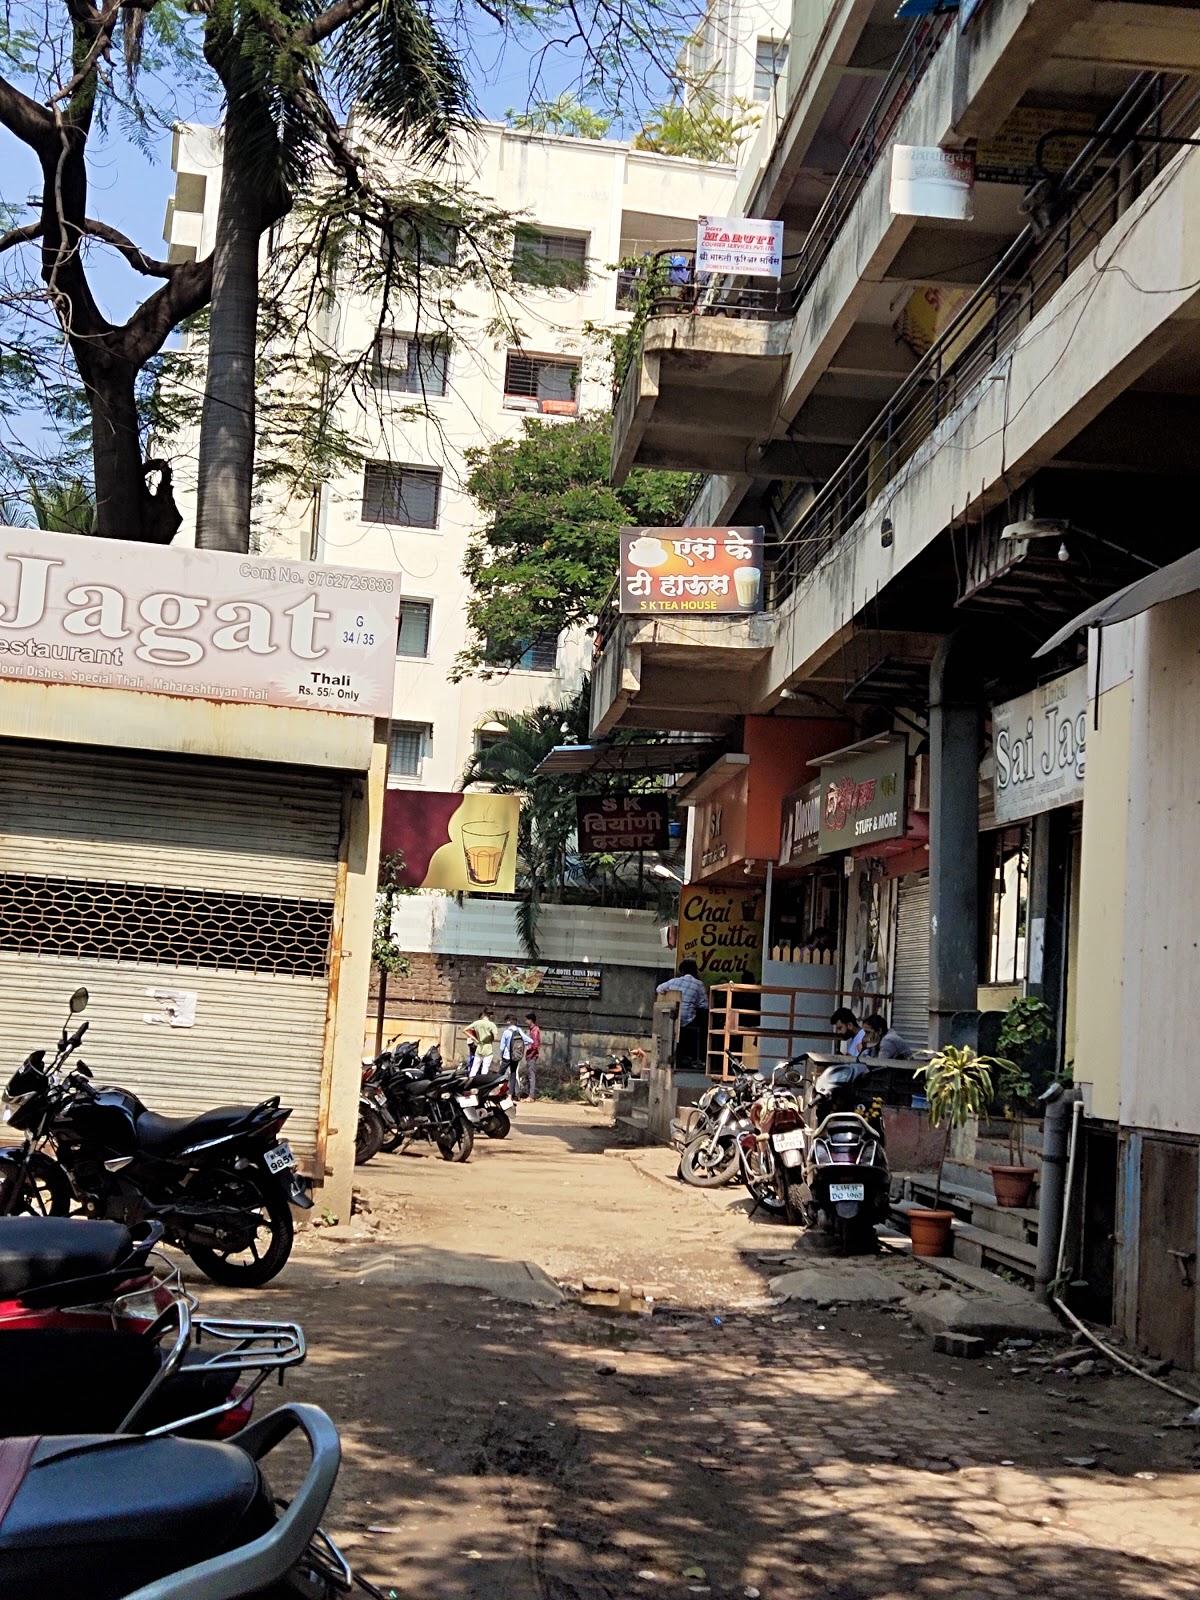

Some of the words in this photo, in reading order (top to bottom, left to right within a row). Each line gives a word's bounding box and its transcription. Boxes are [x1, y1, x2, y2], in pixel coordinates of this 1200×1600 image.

[703, 232, 775, 245] MARUTI
[671, 536, 718, 567] एस
[723, 530, 754, 560] के
[239, 562, 276, 581] Cont
[279, 567, 304, 584] No.
[308, 570, 394, 594] 9762725838
[626, 569, 653, 596] टी
[658, 574, 730, 597] हाऊस
[0, 553, 331, 667] Jagat
[640, 600, 647, 610] S
[649, 600, 657, 610] K
[659, 600, 679, 610] TEA
[681, 600, 717, 610] HOUSE
[356, 616, 364, 628] G
[0, 637, 123, 666] estaurant
[342, 631, 354, 644] 34
[363, 633, 375, 646] 35
[71, 669, 112, 685] Special
[116, 673, 143, 688] Thali
[153, 677, 238, 698] Maharashtriyan
[242, 687, 268, 701] Thali
[311, 671, 351, 686] Thali
[298, 685, 314, 696] Rs.
[337, 689, 360, 701] Only
[996, 717, 1034, 789] Sai
[602, 798, 618, 812] S
[623, 797, 641, 811] K
[854, 816, 874, 836] STUFF
[878, 810, 898, 831] MORE
[684, 895, 732, 923] Chai
[701, 923, 758, 949] Sutta
[698, 948, 748, 973] Yaari
[270, 1153, 294, 1171] 9851
